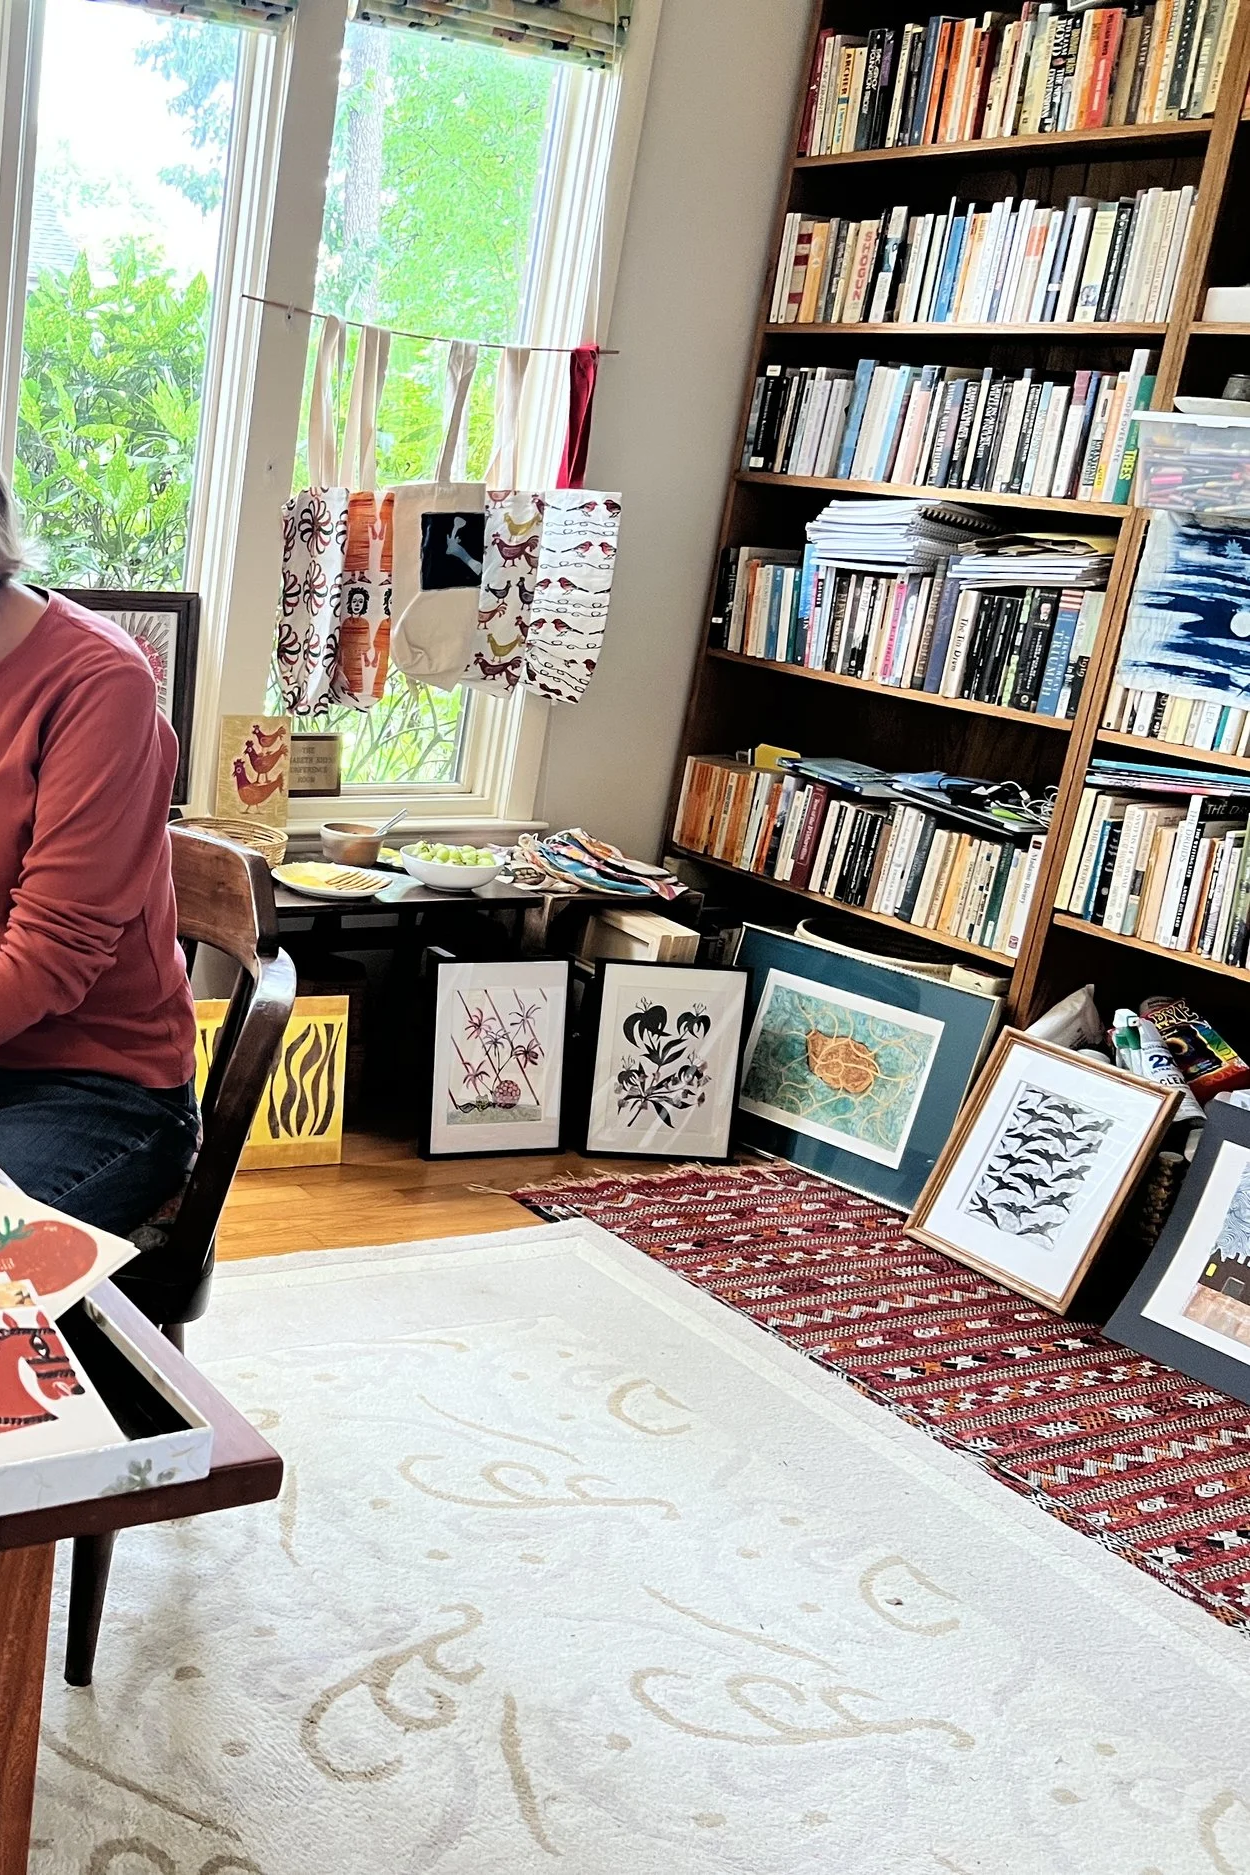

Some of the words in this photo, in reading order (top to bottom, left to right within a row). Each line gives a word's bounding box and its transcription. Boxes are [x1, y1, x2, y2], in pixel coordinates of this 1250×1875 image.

[1051, 20, 1067, 56] BOYD
[1060, 18, 1074, 56] WILLIAM
[840, 53, 853, 95] ARCHER
[1122, 396, 1134, 419] HOPE
[975, 418, 990, 459] FAULKNER
[1117, 421, 1128, 441] OVER
[1112, 444, 1123, 463] FATE
[1118, 449, 1139, 480] TREES
[927, 580, 943, 620] NADINE
[957, 618, 969, 633] The
[915, 623, 935, 675] GORDIMER
[955, 635, 966, 648] Tin
[1058, 635, 1070, 660] FIRST
[949, 649, 962, 673] Drum
[1041, 629, 1064, 697] TRIUMPH
[1076, 657, 1089, 678] 1919
[1052, 663, 1064, 693] GREAT
[1187, 809, 1198, 827] THE
[1207, 804, 1228, 815] THE
[1089, 828, 1100, 844] THE
[1123, 820, 1133, 837] GREAT
[1129, 813, 1143, 845] SYSTEMS
[1194, 828, 1202, 839] THE
[1083, 843, 1096, 865] BONE
[1178, 828, 1193, 863] DRUIDS
[1188, 839, 1199, 865] WRITING
[905, 853, 921, 895] HEMINGWAY
[1024, 853, 1038, 882] Madame
[1076, 863, 1091, 892] PEOPLE
[1120, 857, 1133, 890] SURVIVAL
[1185, 865, 1194, 878] LIFE
[1018, 882, 1031, 904] Bovary
[1180, 885, 1189, 903] ANNIE
[1174, 903, 1185, 928] DILLARD
[1148, 1000, 1199, 1024] DYE
[1149, 1054, 1178, 1069] 2X
